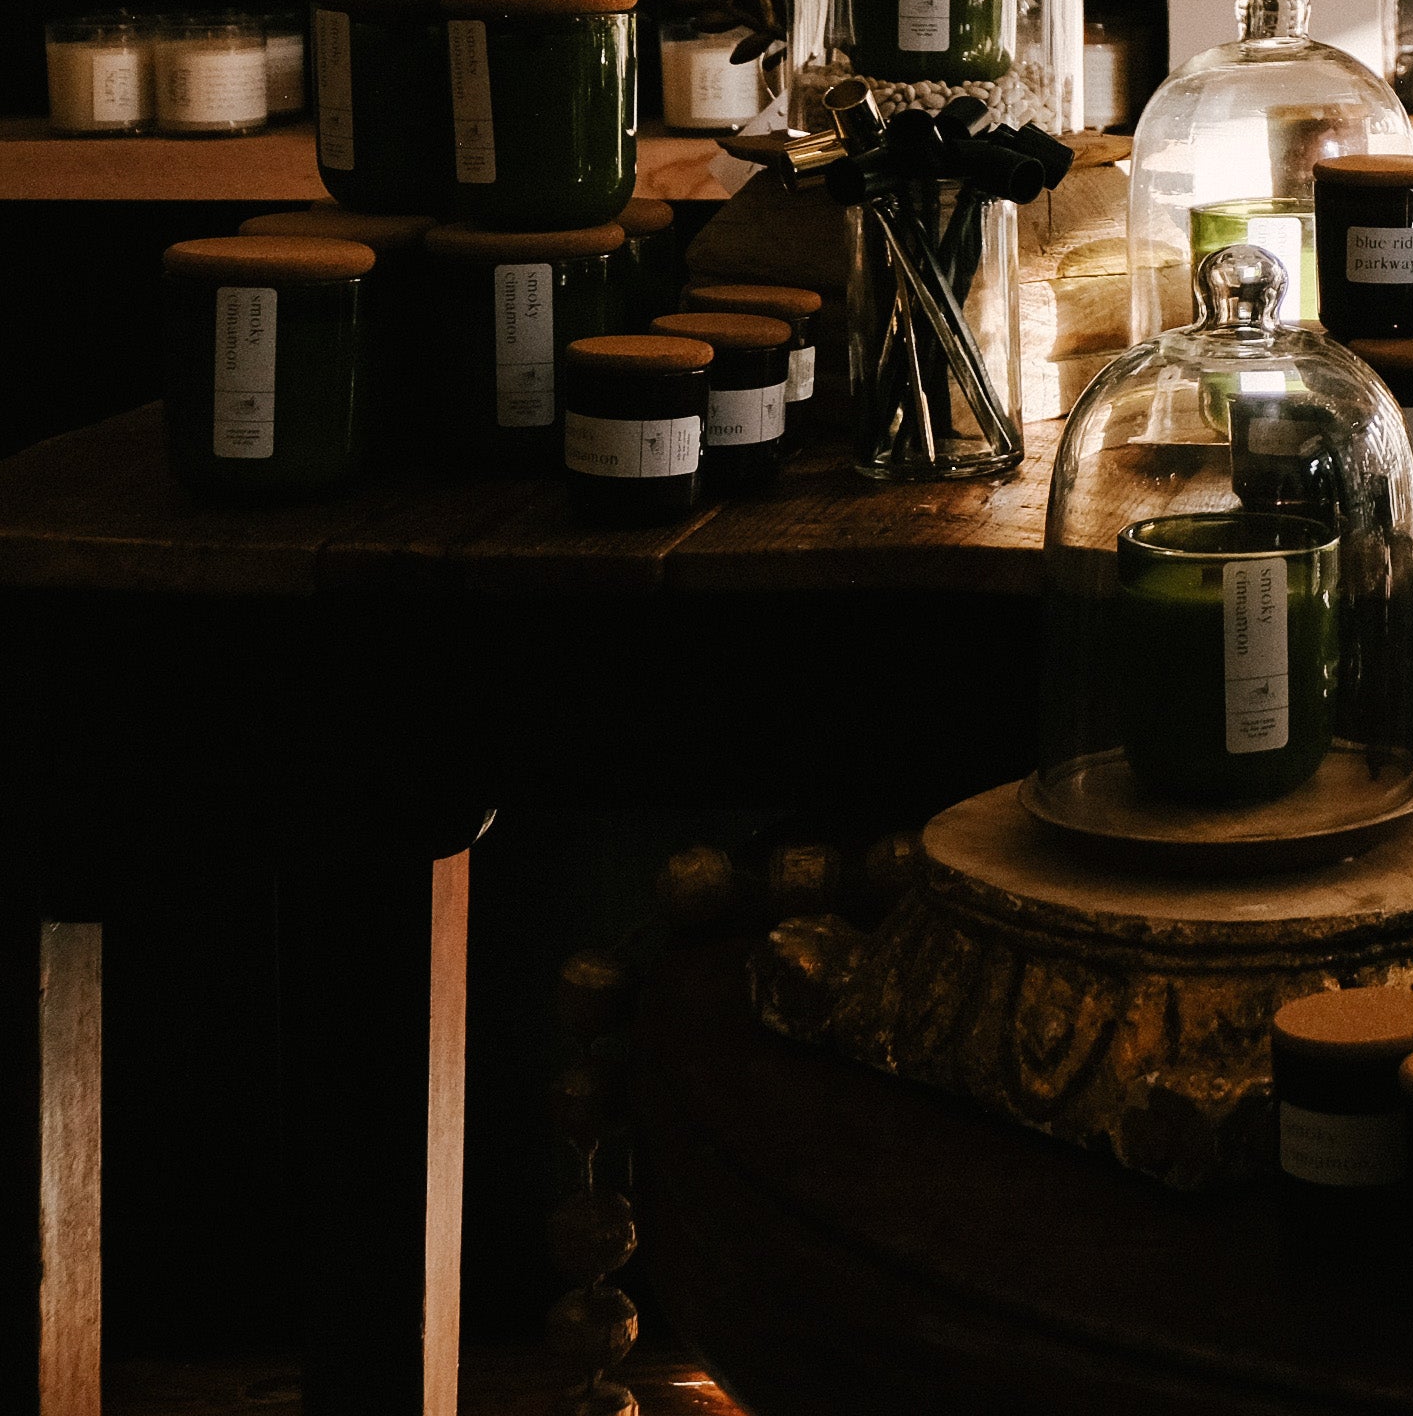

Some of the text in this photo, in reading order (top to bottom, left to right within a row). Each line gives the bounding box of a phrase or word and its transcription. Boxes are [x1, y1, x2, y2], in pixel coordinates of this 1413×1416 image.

[1355, 234, 1387, 250] blue
[249, 295, 264, 345] smoky
[505, 272, 517, 344] cinnamon
[525, 271, 542, 320] smoky
[226, 294, 238, 371] cinnamon
[1235, 570, 1250, 656] cinnamon
[1258, 568, 1276, 624] smoky
